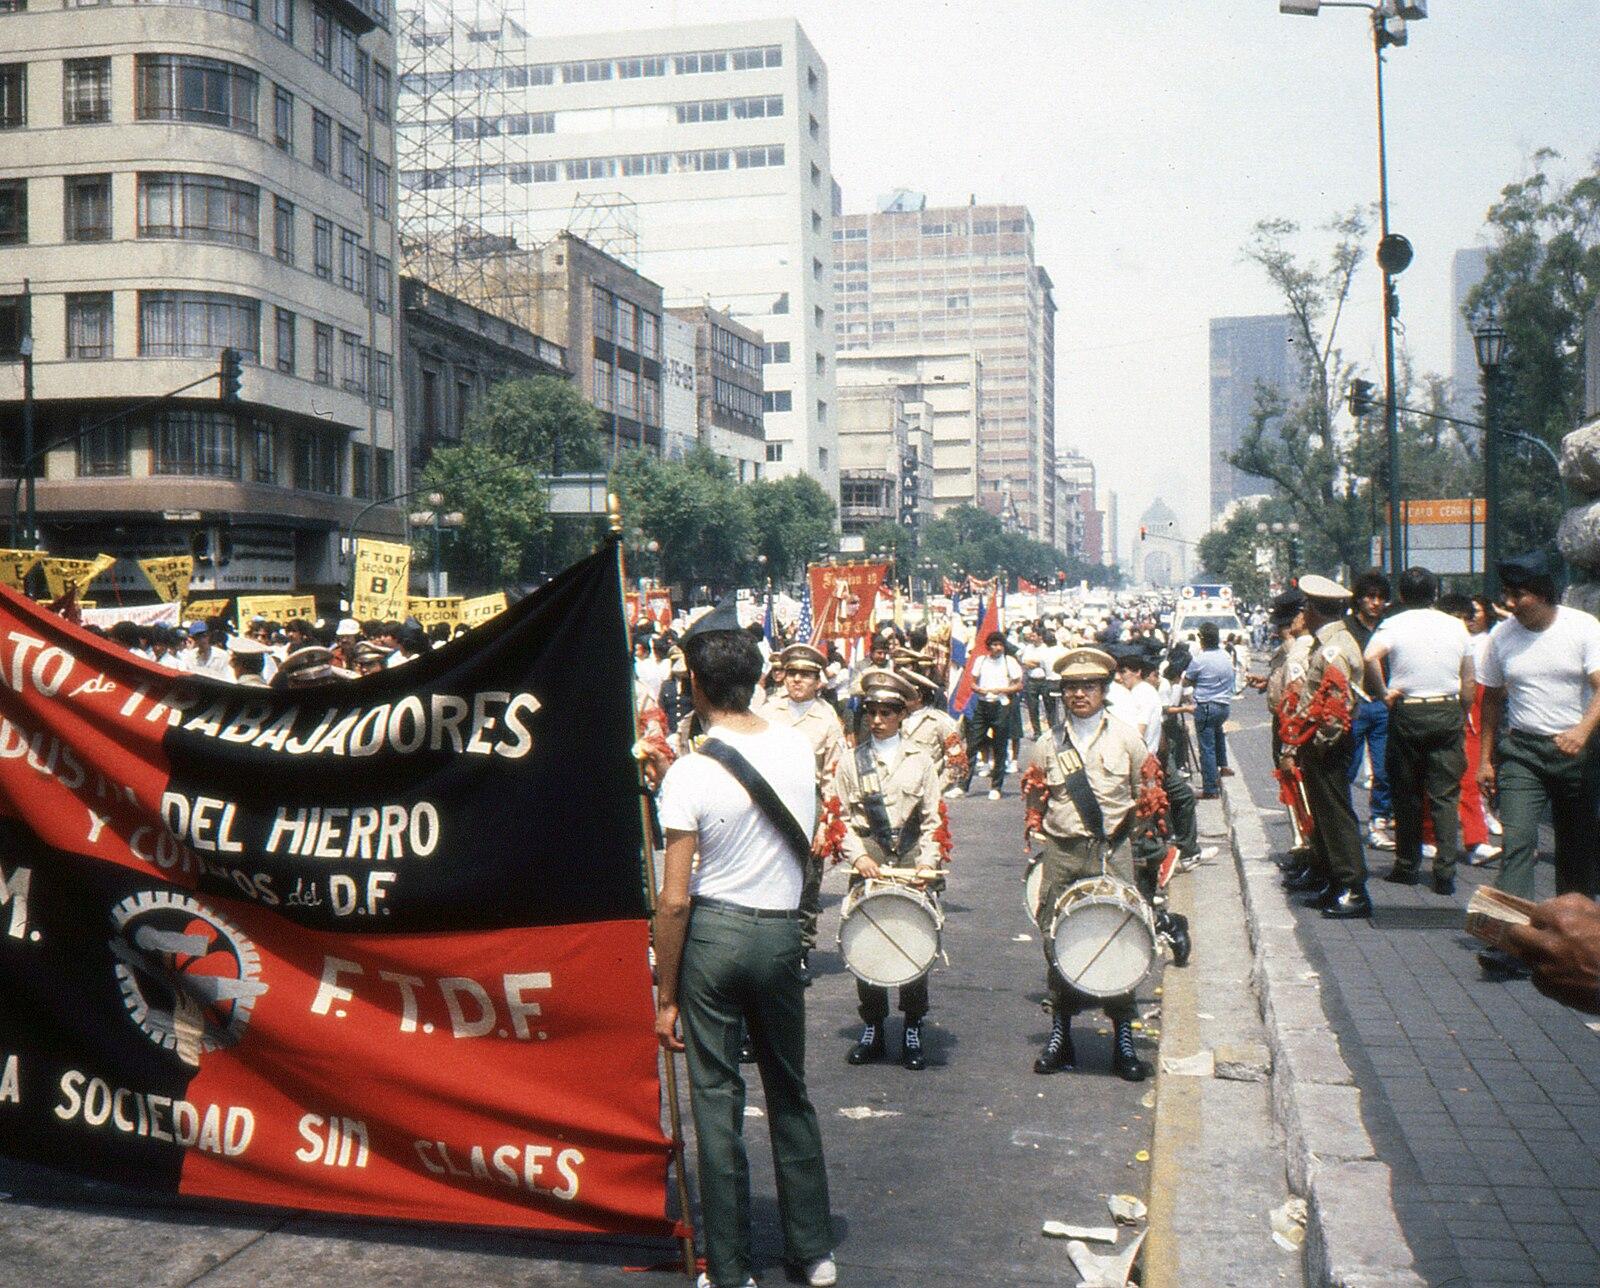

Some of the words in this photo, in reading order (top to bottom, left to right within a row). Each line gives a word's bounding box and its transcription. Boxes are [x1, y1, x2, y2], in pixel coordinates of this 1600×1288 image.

[0, 631, 76, 698] TO
[68, 673, 117, 698] de
[87, 807, 110, 843] Y
[330, 871, 397, 917] D.F.
[160, 791, 244, 853] DEL
[265, 801, 440, 859] HIERRO
[54, 1069, 255, 1158] SOCIEDAD
[414, 1138, 586, 1202] CLASES
